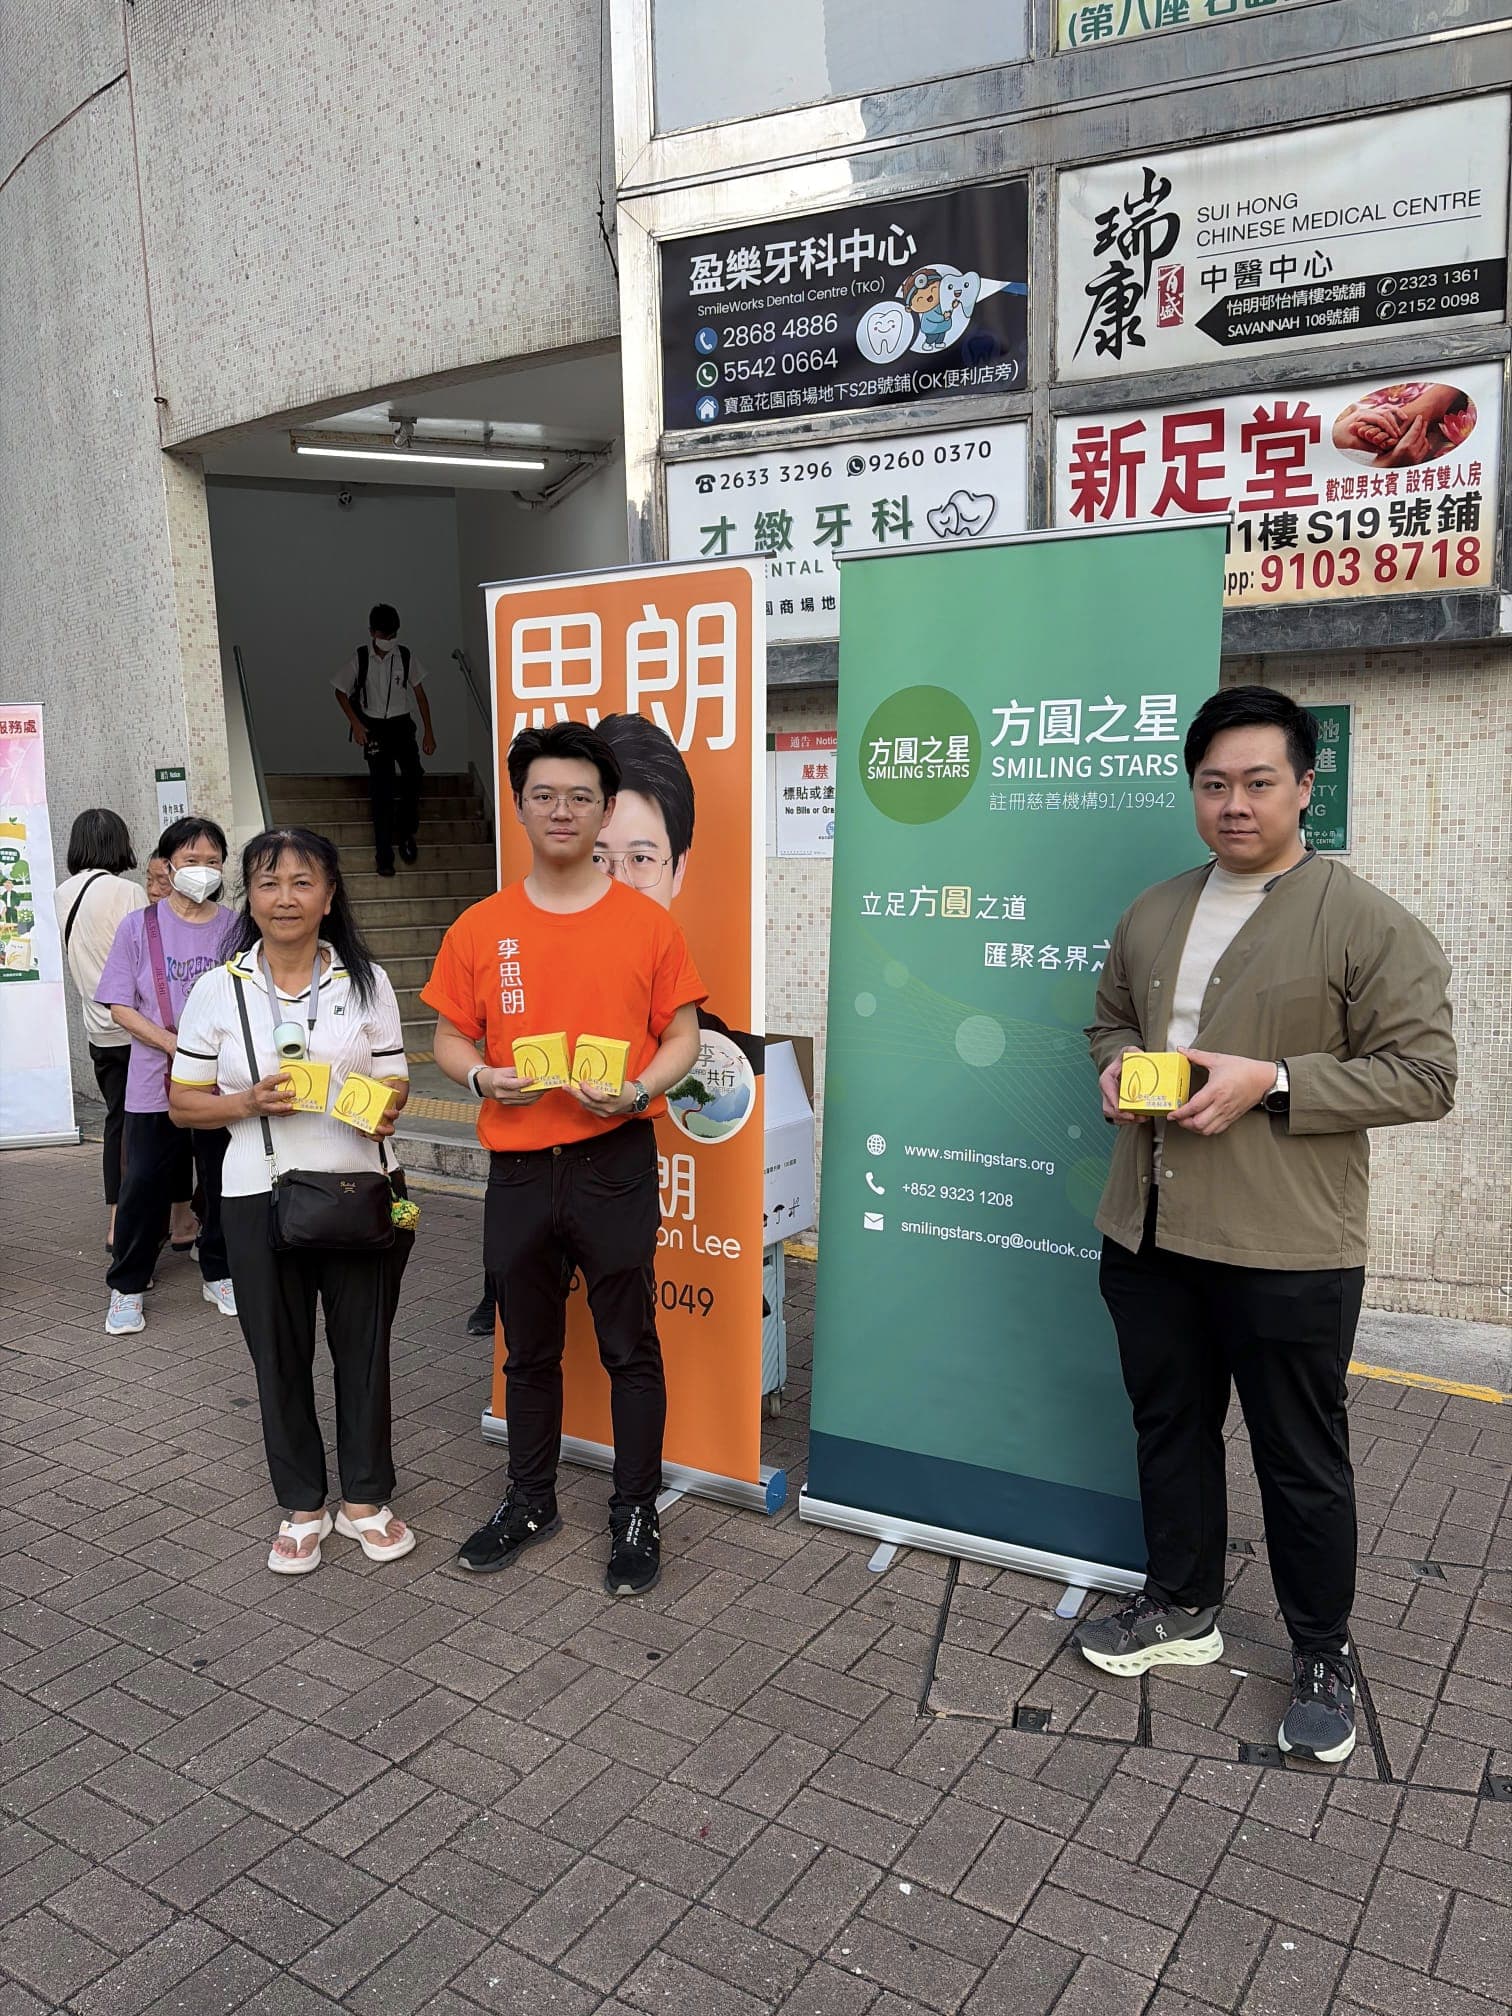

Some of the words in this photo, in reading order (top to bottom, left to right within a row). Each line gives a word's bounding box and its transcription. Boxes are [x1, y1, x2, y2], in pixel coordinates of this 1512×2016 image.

[1197, 221, 1286, 247] CHINESE
[1292, 205, 1385, 234] MEDICAL
[1393, 189, 1482, 217] CENTRE
[1198, 203, 1230, 223] SUI
[1237, 192, 1298, 216] HONG
[689, 223, 917, 296] 盈樂牙科中心
[1200, 249, 1333, 294] 中醫中心
[1399, 271, 1438, 291] 2323
[1443, 267, 1480, 287] 1361
[697, 297, 765, 318] SmileWorks
[766, 290, 804, 308] Dental
[807, 284, 849, 304] Centre
[850, 275, 886, 299] (TKO)
[1397, 295, 1437, 315] 2152
[1441, 291, 1480, 310] 0098
[722, 321, 776, 348] 2868
[781, 313, 838, 341] 4886
[1227, 313, 1300, 338] SAVANNAH
[723, 356, 776, 383] 5542
[781, 348, 838, 376] 0664
[868, 448, 925, 473] 9260
[933, 440, 992, 465] 0370
[1068, 400, 1322, 523] 新足堂
[719, 467, 769, 490] 2633
[779, 460, 833, 484] 3296
[1325, 471, 1399, 504] 歡迎男女賓
[1405, 461, 1483, 494] 設有雙人房
[700, 494, 914, 556] 才緻牙科
[1307, 505, 1381, 546] S19
[764, 559, 825, 580] NTAL
[1261, 547, 1361, 594] 9103
[1374, 536, 1482, 584] 8718
[990, 694, 1181, 748] 方圓之星
[868, 735, 971, 766] 方圓之星
[991, 755, 1092, 779] SMILING
[1099, 753, 1178, 778] STARS
[867, 764, 924, 780] SMILING
[926, 763, 970, 779] STARS
[785, 806, 794, 815] No
[812, 807, 820, 815] or
[988, 791, 1176, 811] 註冊慈善機構91/19942
[861, 885, 1027, 920] 立足方圓之道
[497, 937, 525, 1015] 李思朗
[707, 1069, 737, 1088] 共行
[904, 1144, 1055, 1176] www.smilingstars.org
[902, 1182, 936, 1198] +852
[940, 1186, 975, 1202] 9323
[980, 1190, 1014, 1207] 1208
[692, 1223, 742, 1260] Lee
